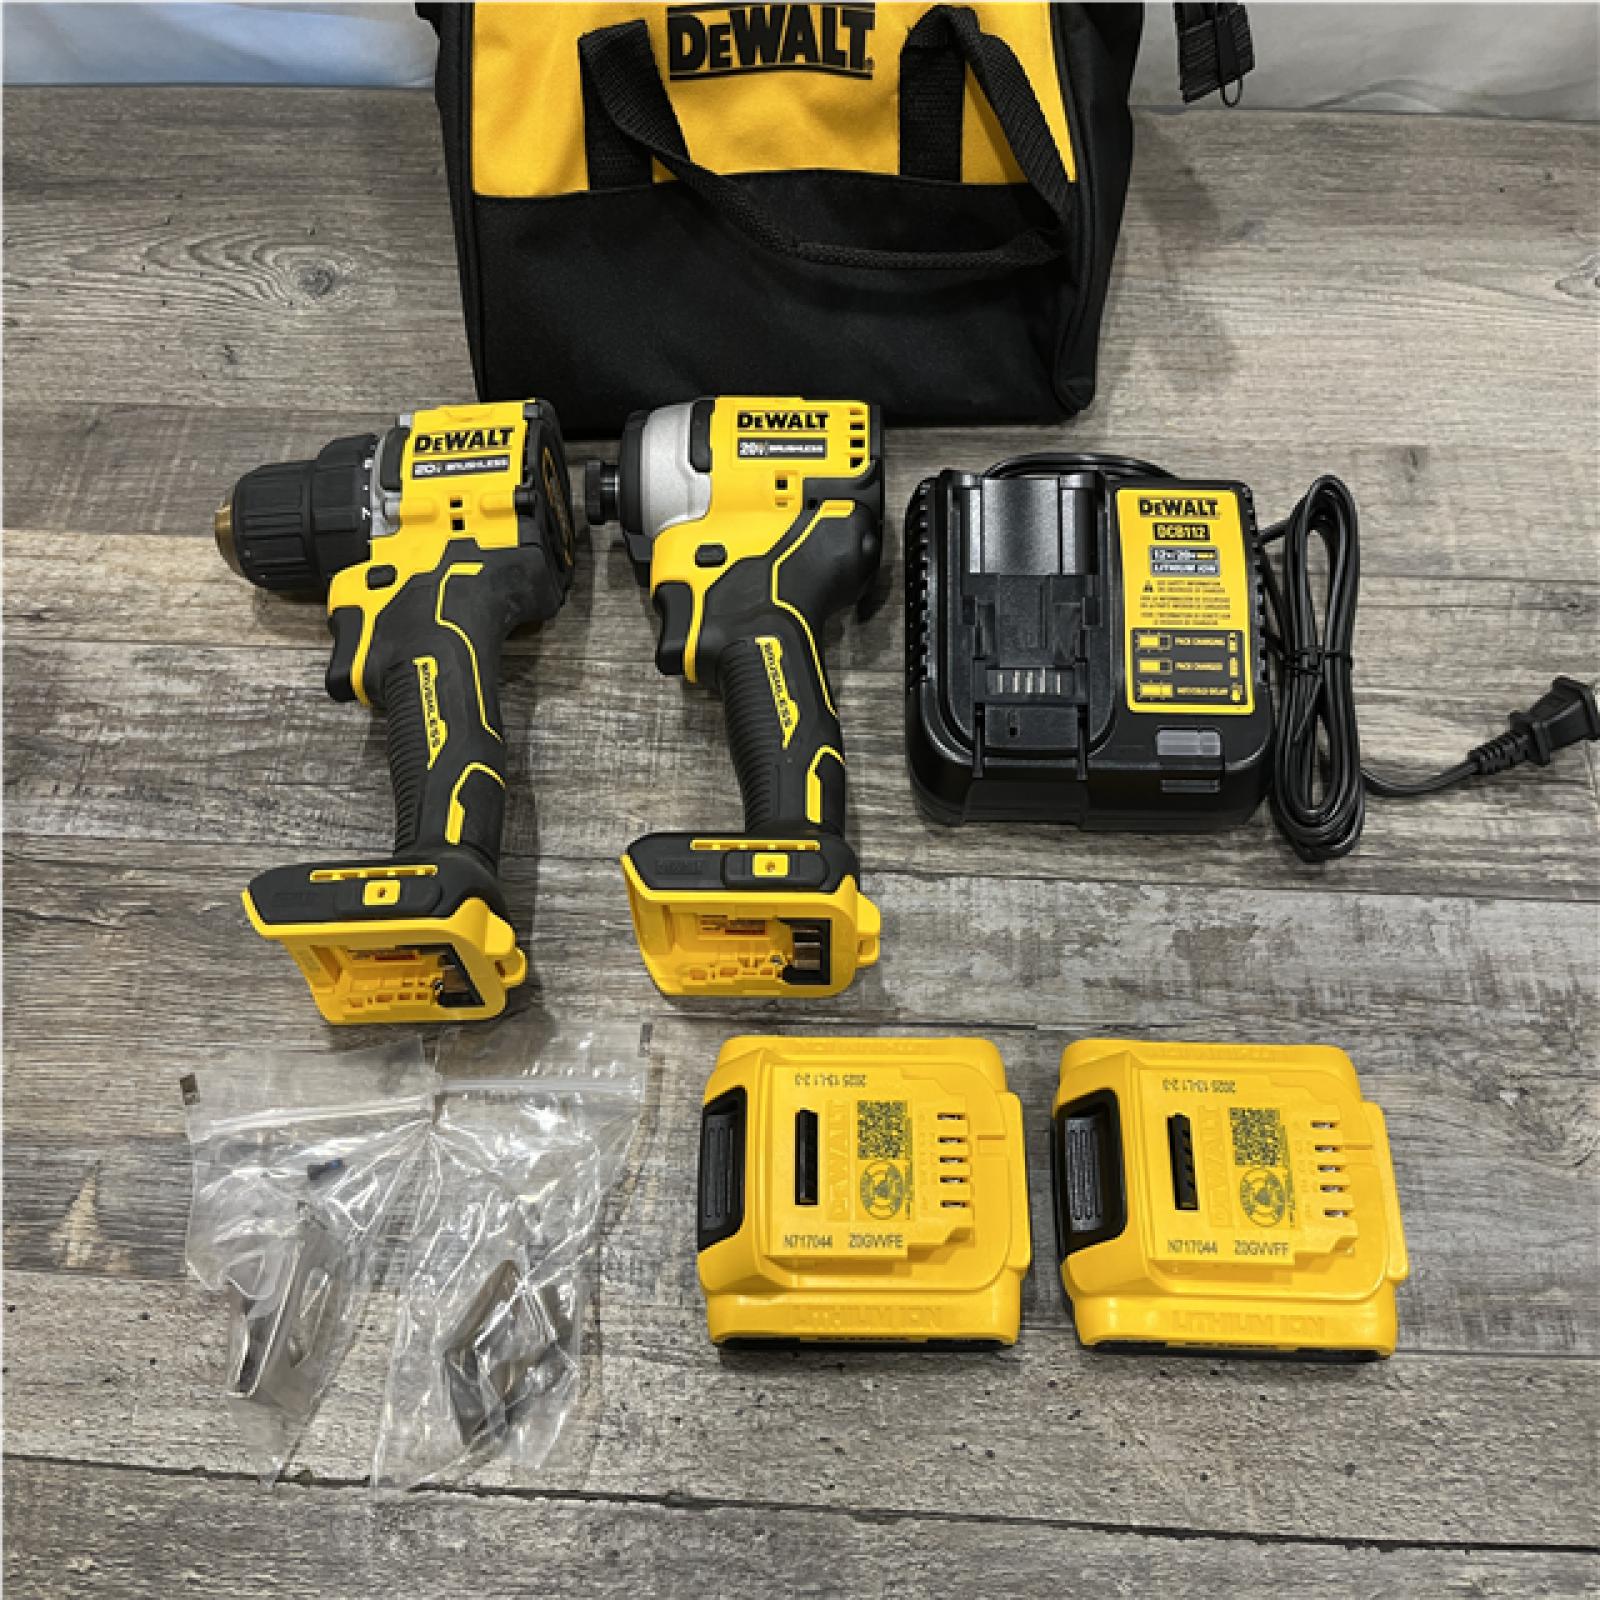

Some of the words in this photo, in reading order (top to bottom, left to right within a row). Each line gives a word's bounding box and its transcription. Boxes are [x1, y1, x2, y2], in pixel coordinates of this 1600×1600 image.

[667, 5, 875, 71] DEWALT
[738, 412, 828, 428] DEWALT
[415, 428, 514, 451] DEWALT
[1140, 498, 1218, 516] DEWALT
